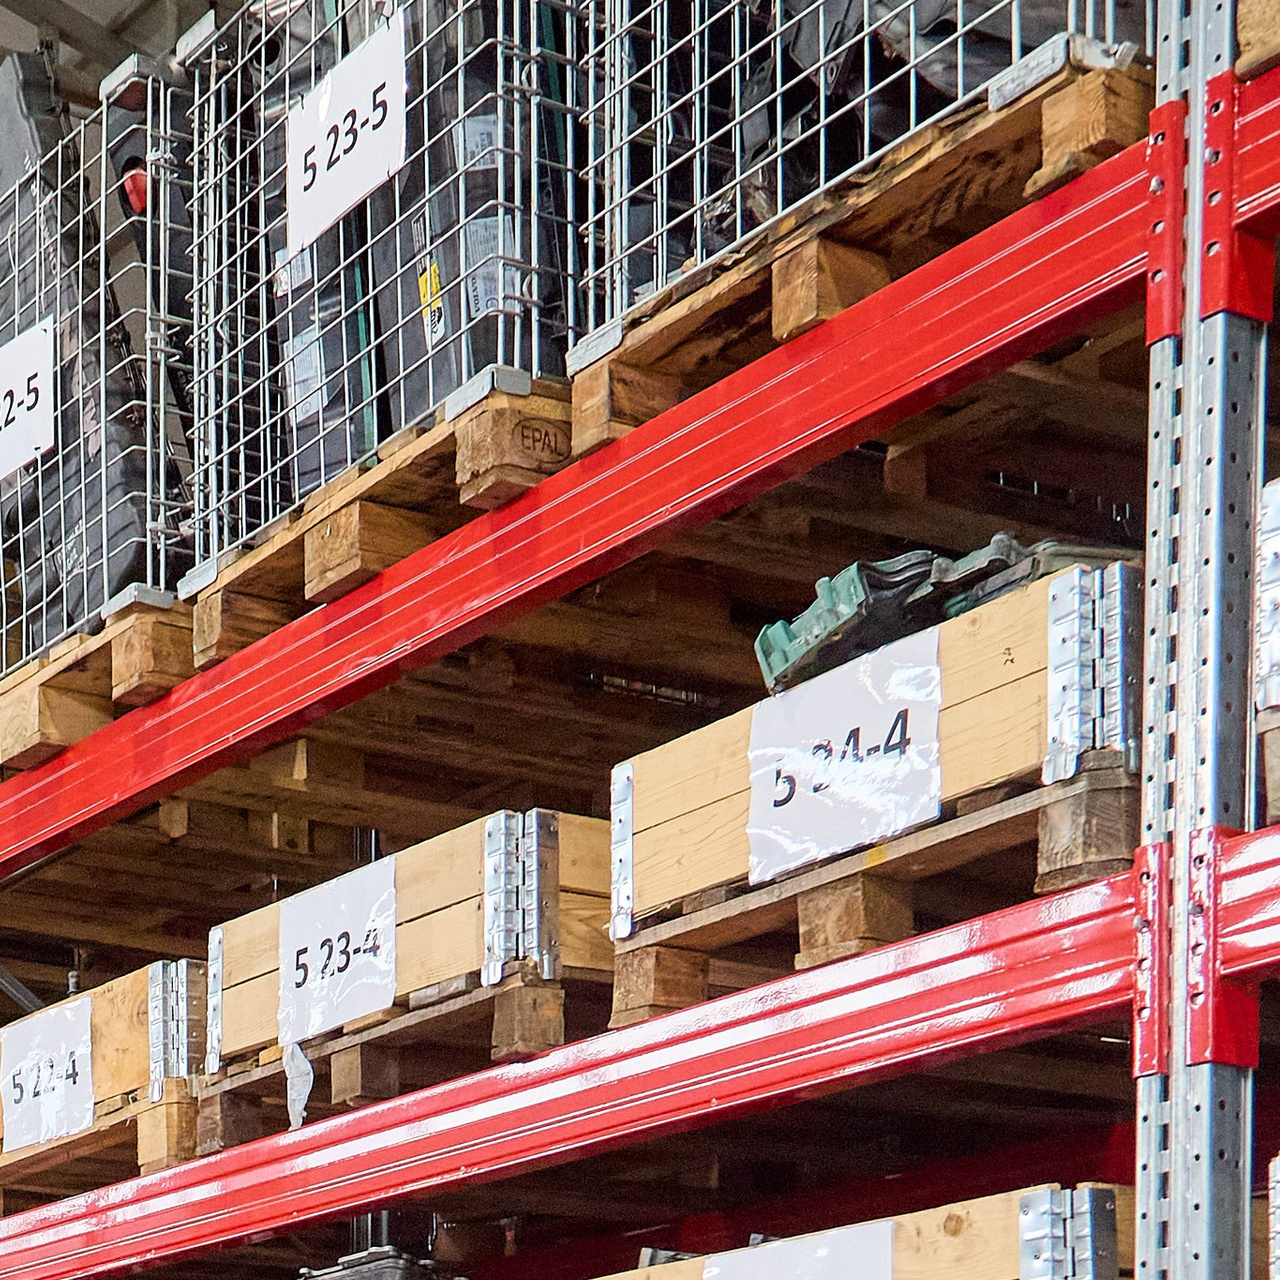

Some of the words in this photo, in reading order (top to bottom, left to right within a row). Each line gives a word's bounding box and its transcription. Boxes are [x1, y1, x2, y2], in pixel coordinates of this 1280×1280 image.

[303, 144, 317, 193] 5
[326, 81, 388, 172] 23-5
[521, 426, 564, 457] EPAL
[294, 946, 309, 989] 5
[12, 1068, 24, 1105] 5
